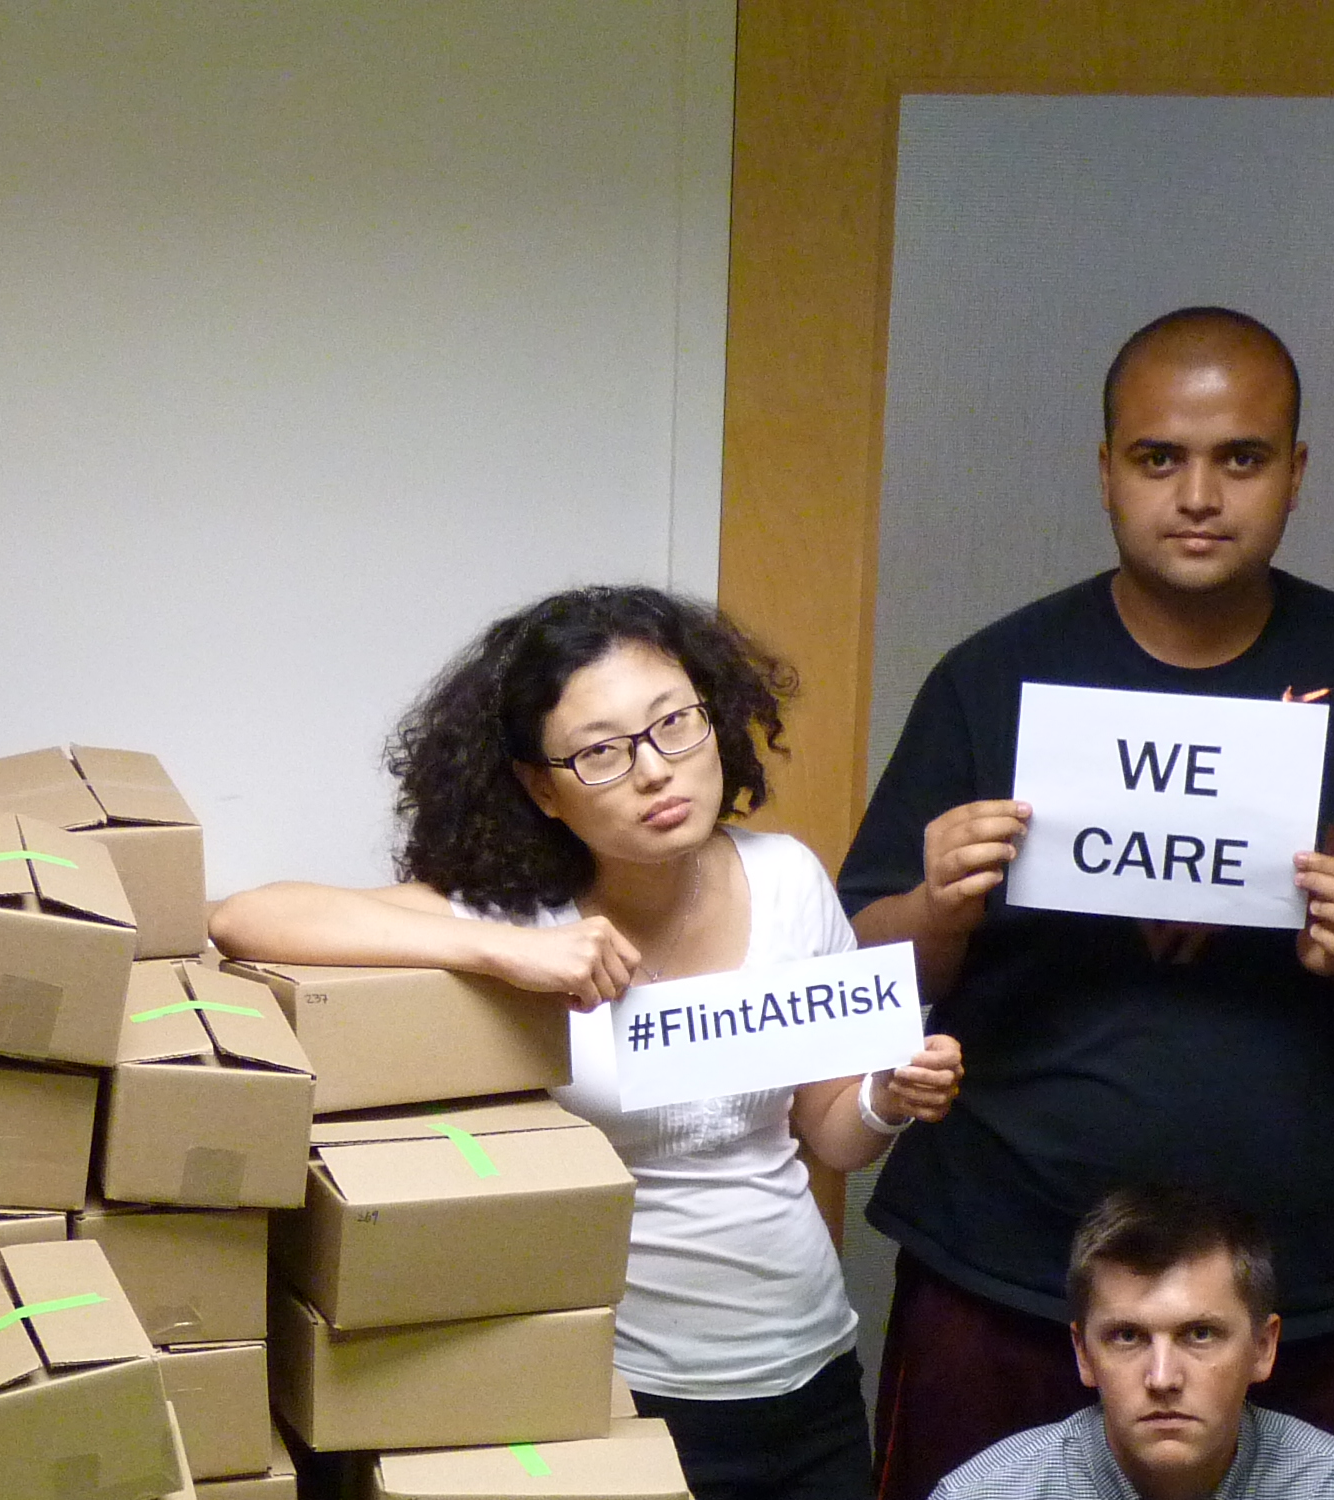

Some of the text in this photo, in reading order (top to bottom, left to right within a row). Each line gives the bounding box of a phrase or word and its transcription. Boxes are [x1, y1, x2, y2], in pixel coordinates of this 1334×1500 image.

[1116, 738, 1222, 797] WE
[1072, 826, 1250, 888] CARE
[303, 993, 329, 1005] 237
[626, 974, 903, 1054] #FlintAtRisk
